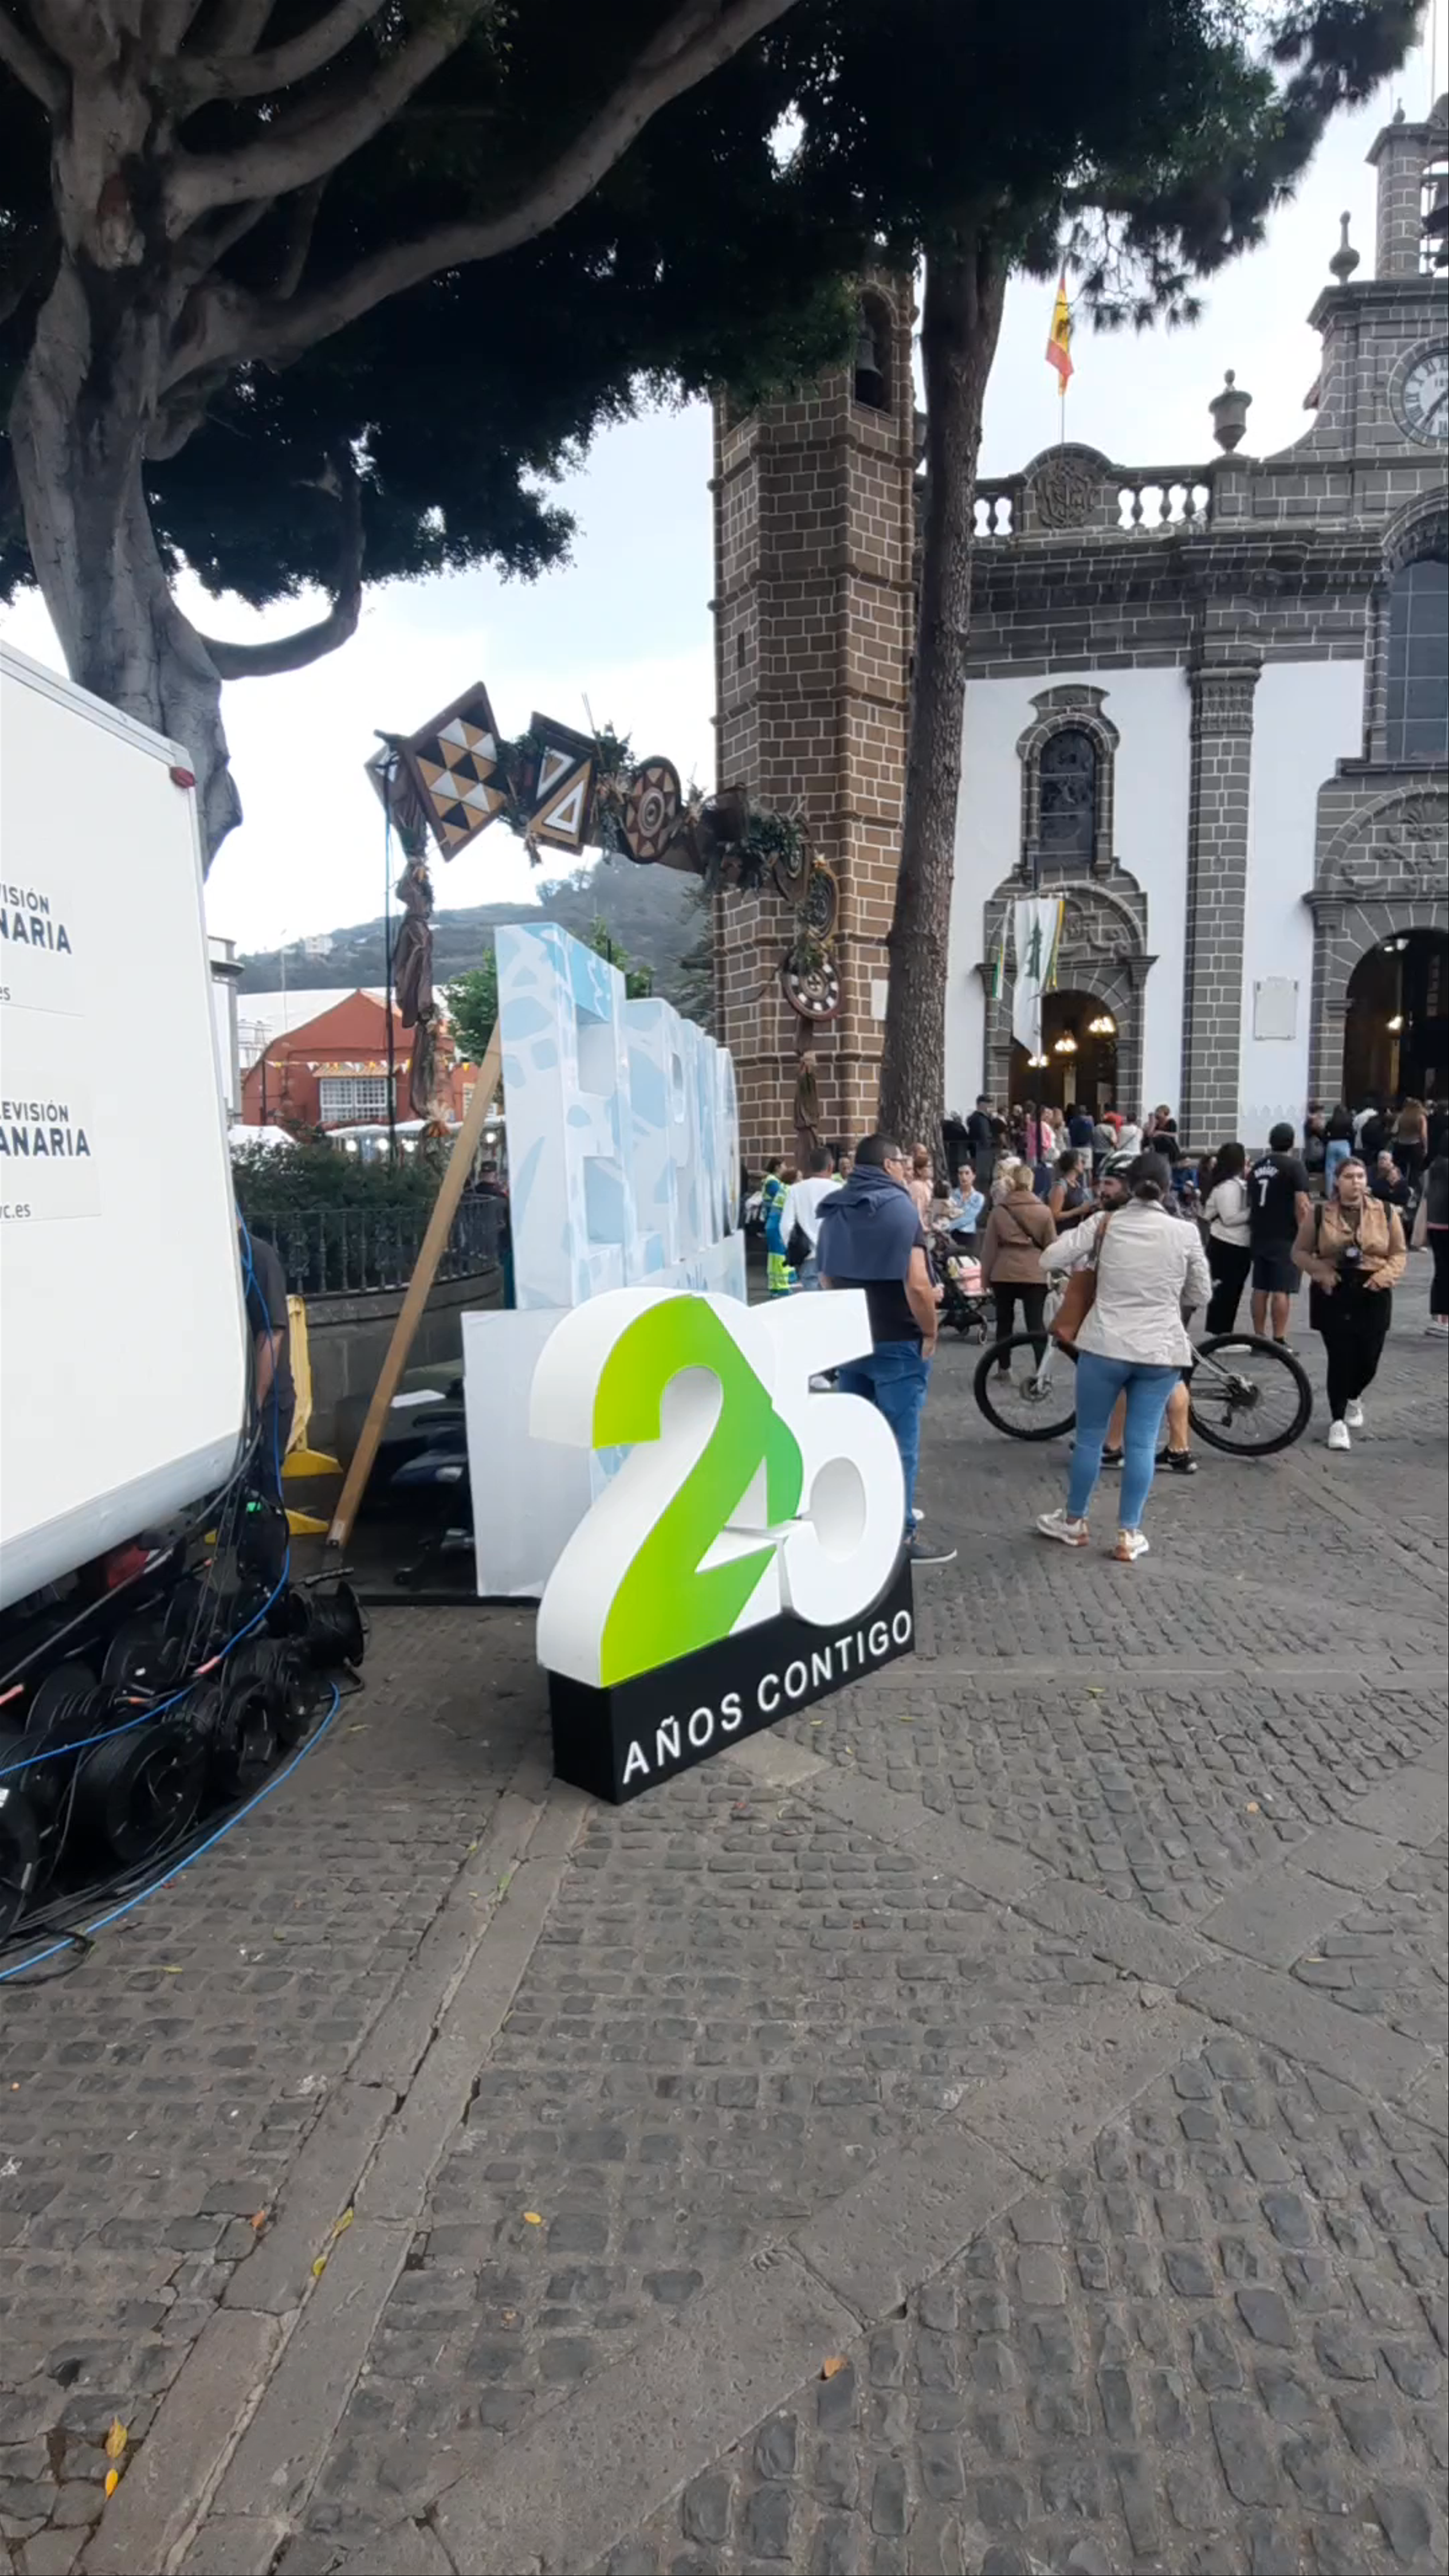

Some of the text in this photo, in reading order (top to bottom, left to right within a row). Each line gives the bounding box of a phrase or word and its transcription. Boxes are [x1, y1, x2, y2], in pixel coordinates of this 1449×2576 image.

[532, 1287, 906, 1688] 25
[623, 1610, 912, 1784] AÑOS CONTIGO
